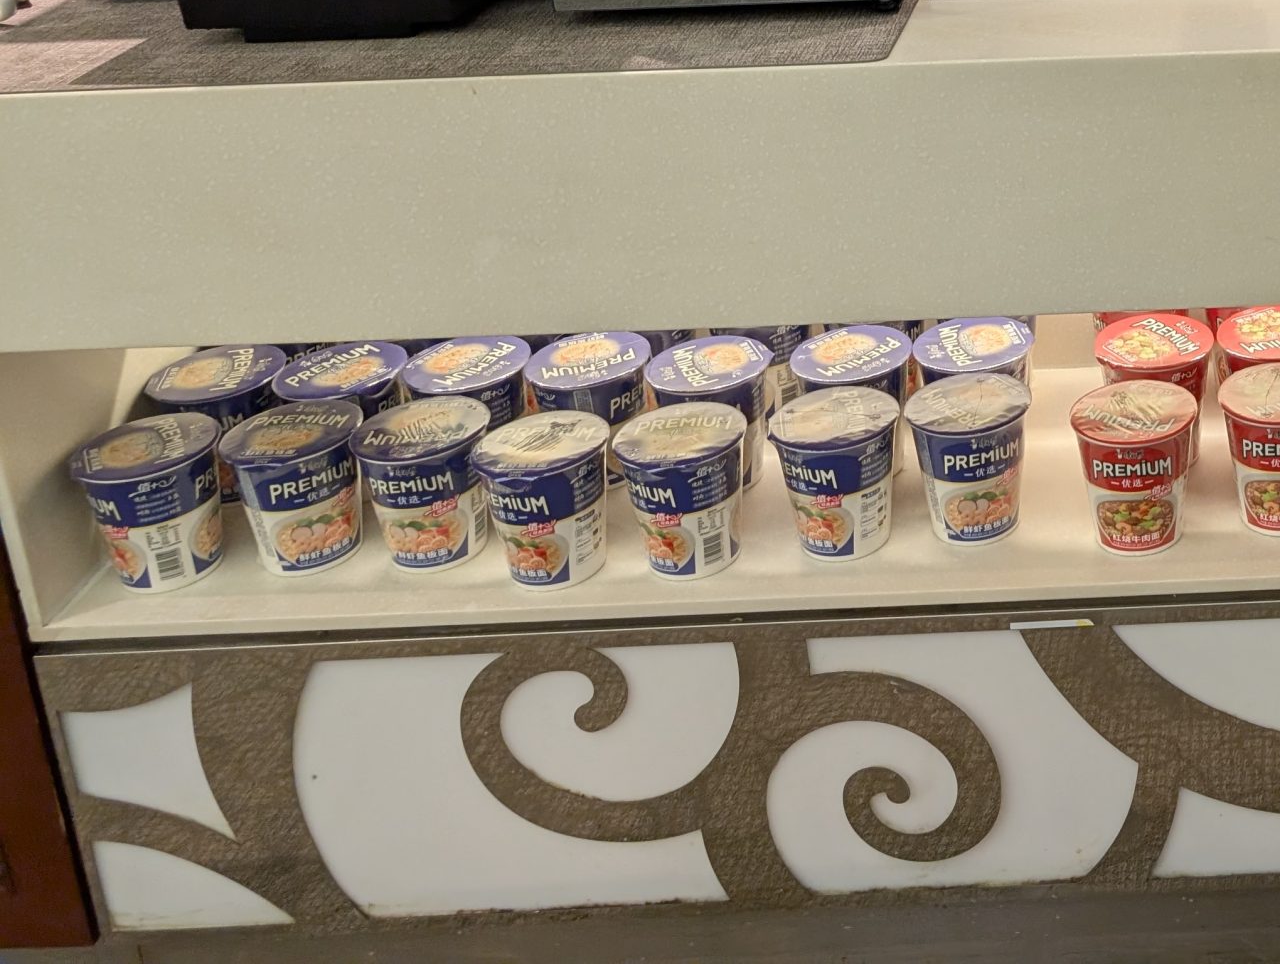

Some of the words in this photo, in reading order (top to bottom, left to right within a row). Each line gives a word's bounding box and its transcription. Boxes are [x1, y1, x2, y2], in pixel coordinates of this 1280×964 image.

[938, 324, 983, 367] PREMIUM
[1132, 318, 1199, 355] PREMIUM
[285, 344, 380, 386] PREMIUM
[432, 342, 516, 386] PREMIUM
[542, 348, 636, 378] PREMIUM
[672, 345, 719, 387] PREMIUM
[816, 337, 901, 377] PREMIUM
[246, 414, 350, 431] PREMIUM
[634, 416, 733, 436] PREMIUM
[944, 439, 1019, 474] PREMIUM
[1093, 457, 1171, 478] PREMIUM
[269, 460, 354, 505] PREMIUM
[369, 471, 454, 496] PREMIUM
[784, 462, 838, 489] EMIUM
[975, 466, 997, 478] 优选
[1121, 479, 1143, 488] 优选
[397, 496, 421, 506] 优选
[489, 495, 550, 516] EMIUM
[627, 483, 676, 508] EMIUM
